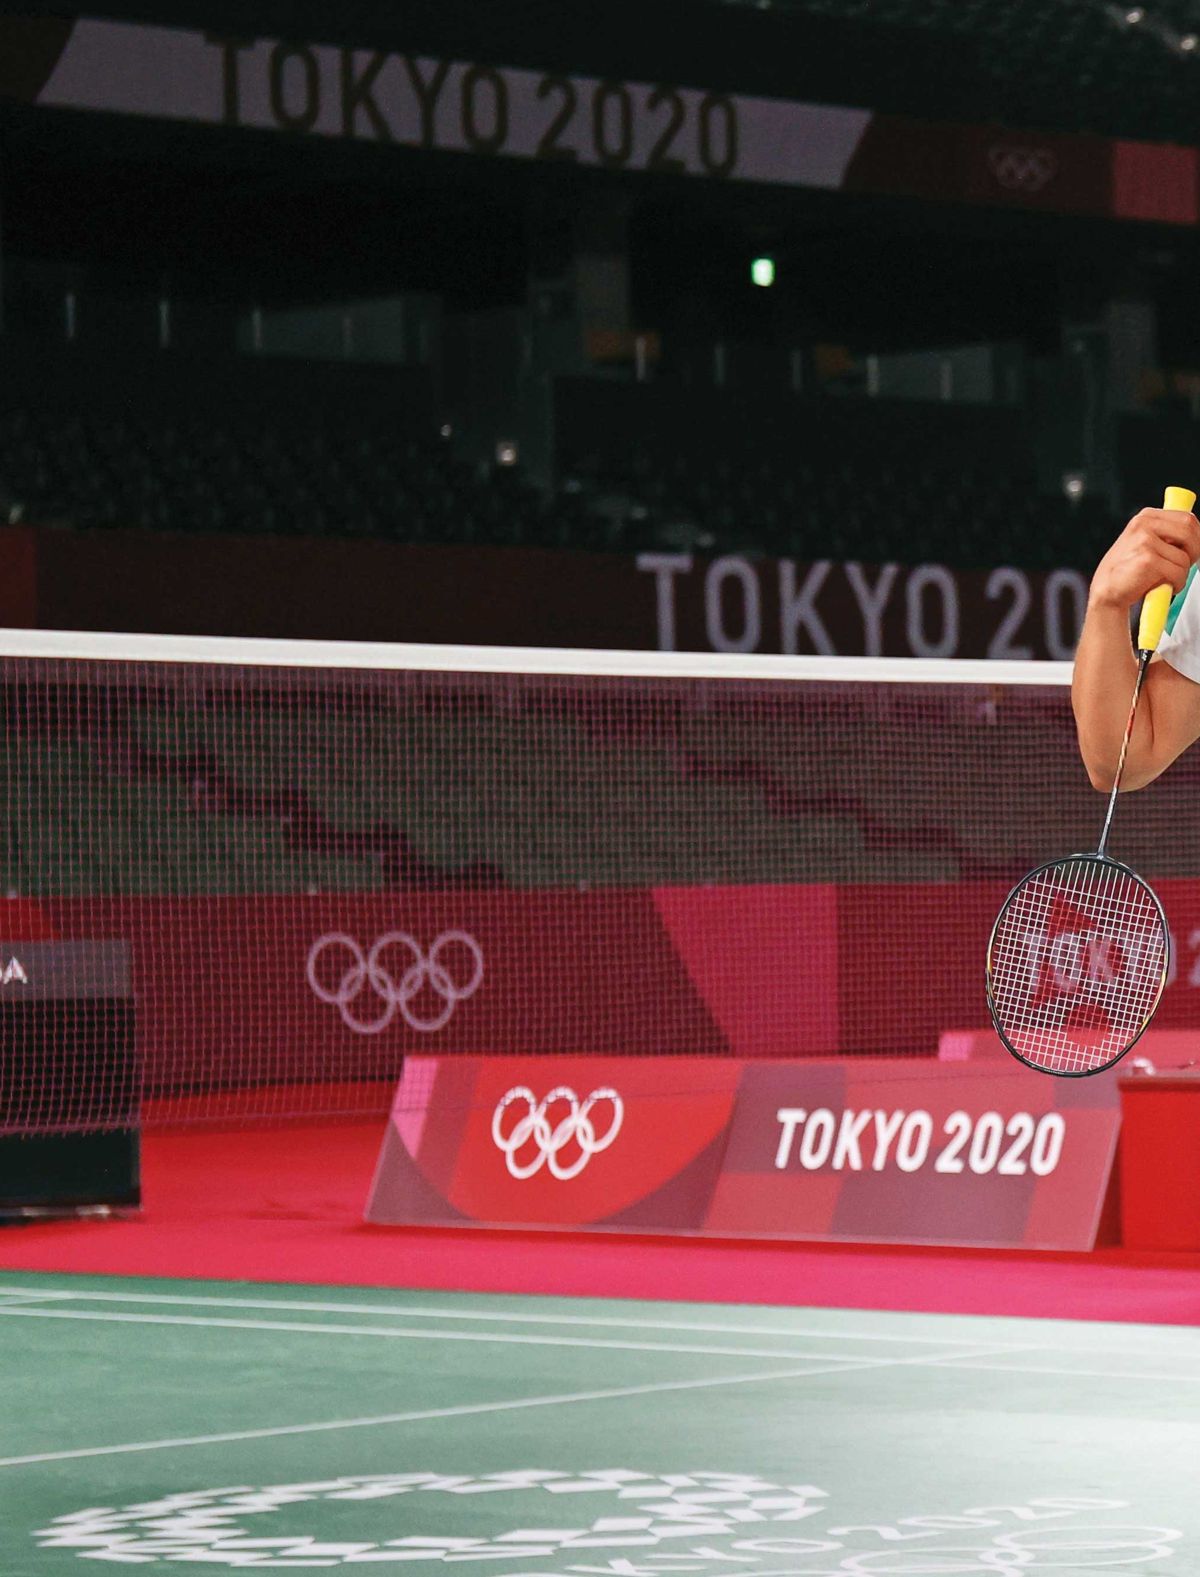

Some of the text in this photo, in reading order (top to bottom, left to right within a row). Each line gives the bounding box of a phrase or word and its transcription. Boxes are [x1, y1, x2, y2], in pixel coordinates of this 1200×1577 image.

[205, 36, 738, 177] TOKYO 2020
[636, 552, 1088, 661] TOKYO 20
[774, 1108, 1066, 1176] TOKYO 2020
